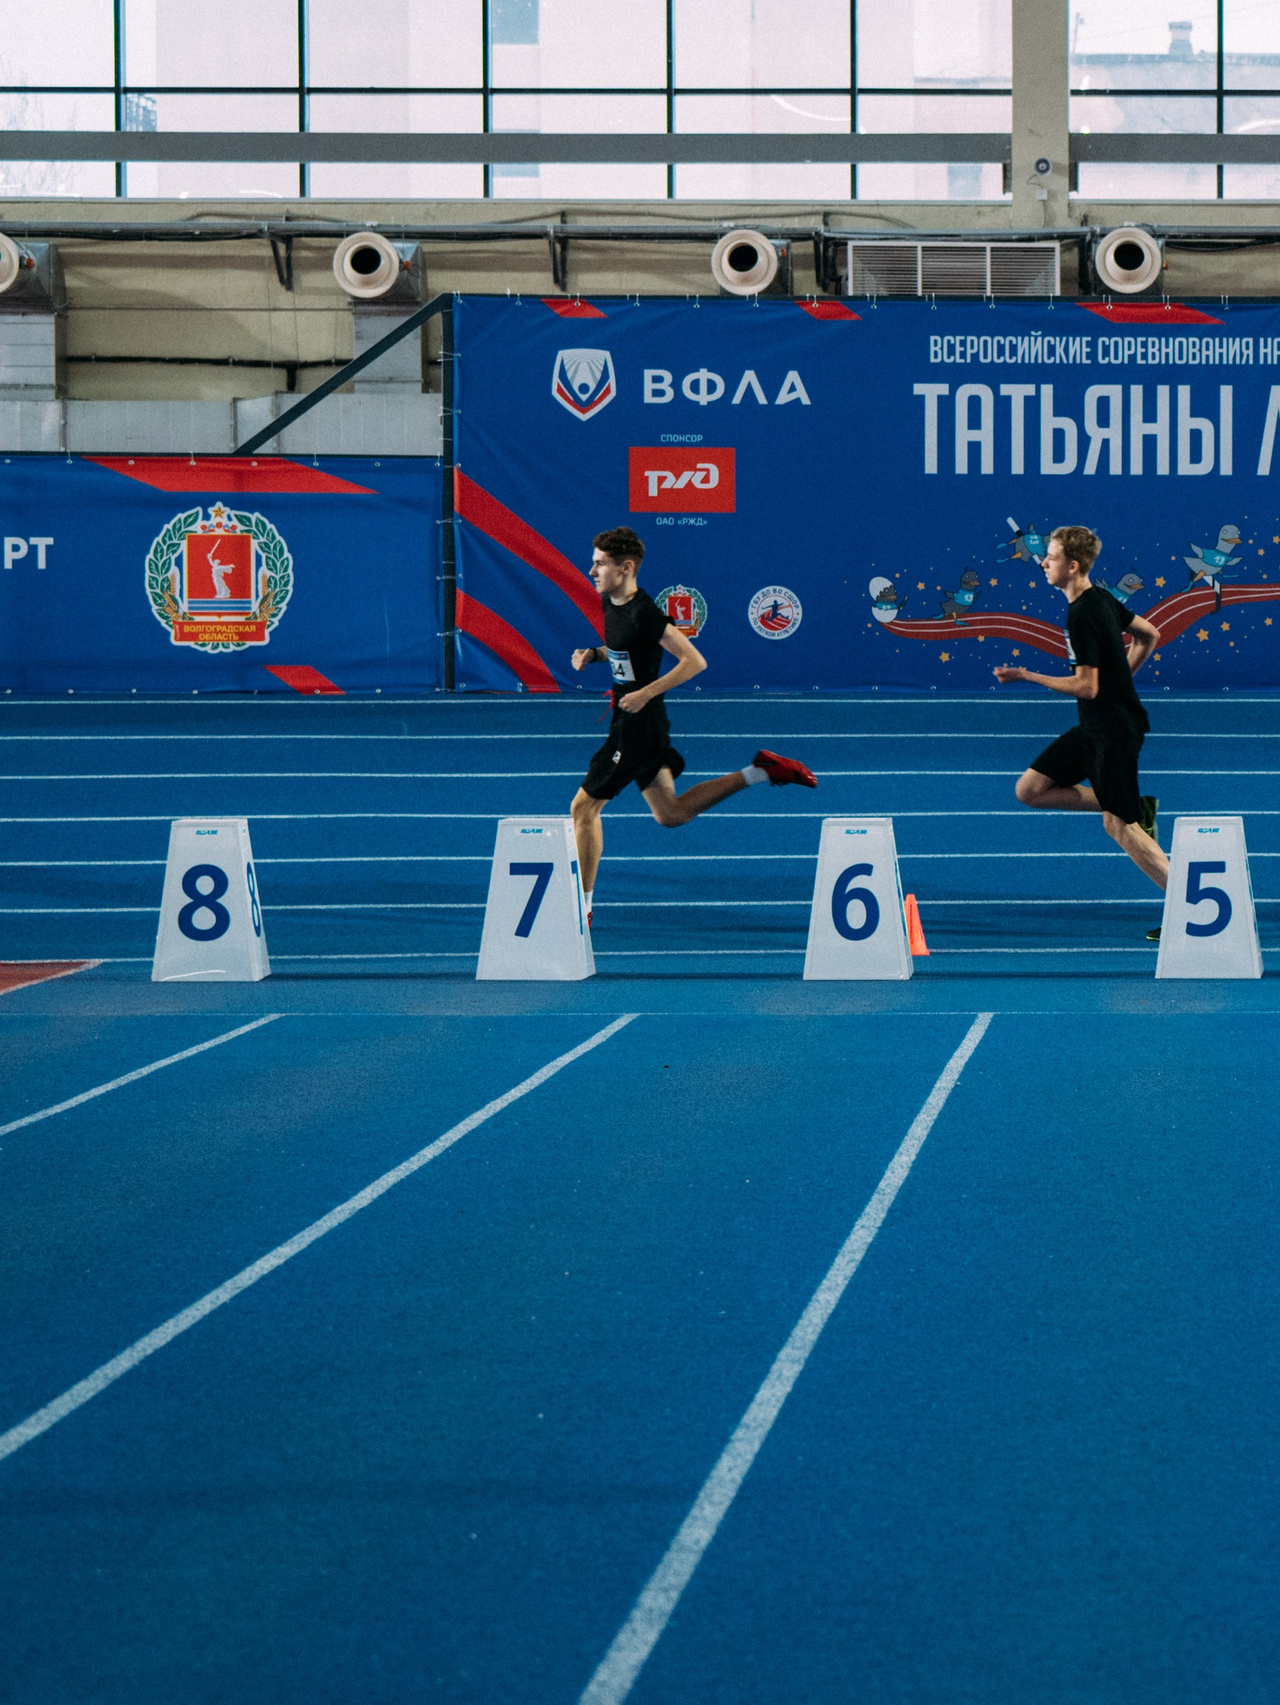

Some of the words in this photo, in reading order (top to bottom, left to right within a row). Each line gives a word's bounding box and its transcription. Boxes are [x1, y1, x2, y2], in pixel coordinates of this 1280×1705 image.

[931, 332, 1091, 364] ВСЕРОССИЙСКИЕ
[1099, 337, 1253, 364] СОРЕВНОВАНИЯ
[644, 368, 812, 406] ВФЛА
[660, 433, 704, 443] СПОНСОР
[914, 384, 1233, 475] ТАТЬЯНЫ
[656, 517, 675, 526] ОАО
[677, 517, 708, 527] «РЖД»
[4, 536, 54, 570] РТ
[1213, 556, 1226, 565] 13
[751, 596, 761, 609] ГБУ
[761, 589, 771, 598] ДО
[784, 591, 800, 609] СШОР
[184, 624, 256, 633] ВОЛГОГРАДСКАЯ
[198, 632, 239, 641] ОБЛАСТЬ
[178, 864, 231, 942] 8
[509, 862, 554, 938] 7
[832, 863, 880, 941] 6
[1186, 861, 1233, 937] 5
